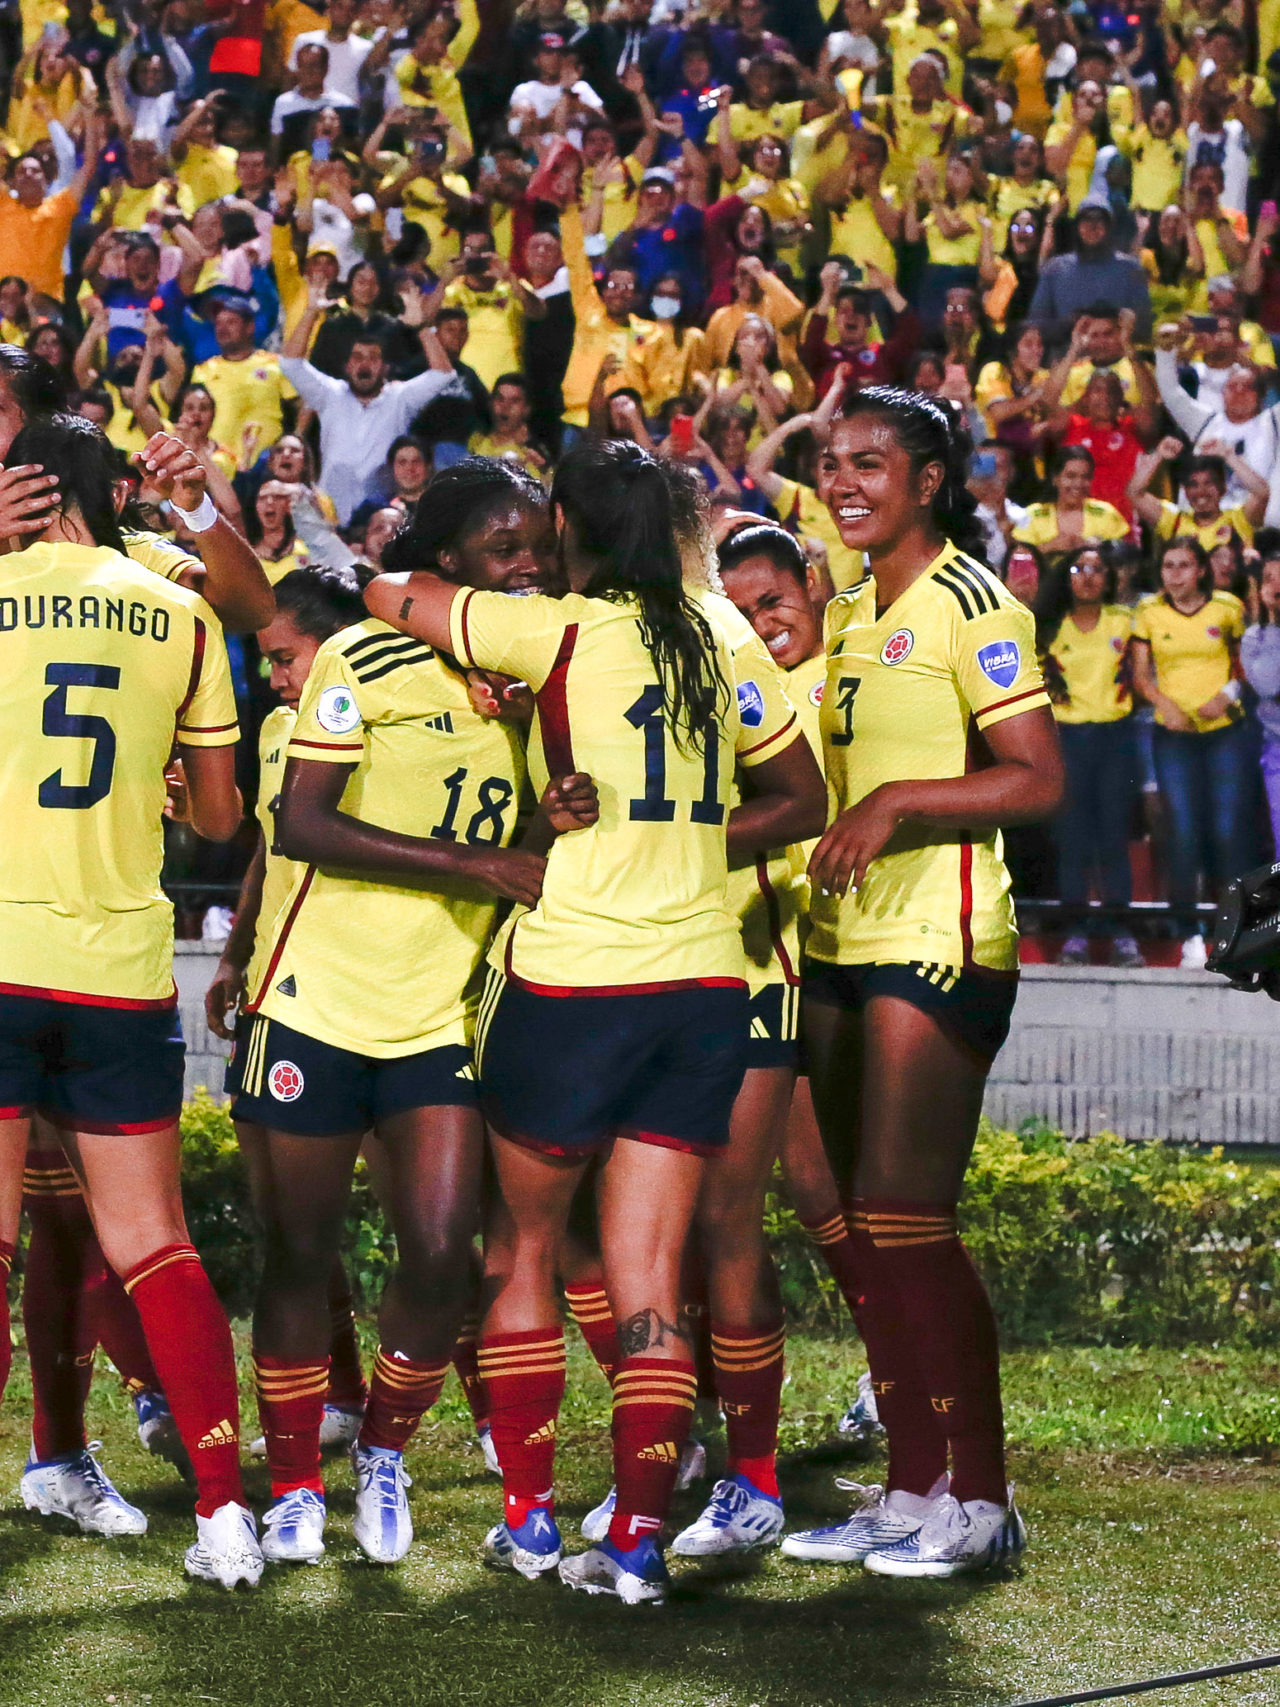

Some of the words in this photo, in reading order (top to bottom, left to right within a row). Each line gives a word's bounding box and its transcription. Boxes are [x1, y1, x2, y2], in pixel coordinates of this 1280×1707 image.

[985, 651, 1017, 668] VIBRA
[38, 661, 121, 809] 5
[831, 676, 862, 746] 3
[623, 683, 726, 826] 11
[431, 765, 515, 848] 18
